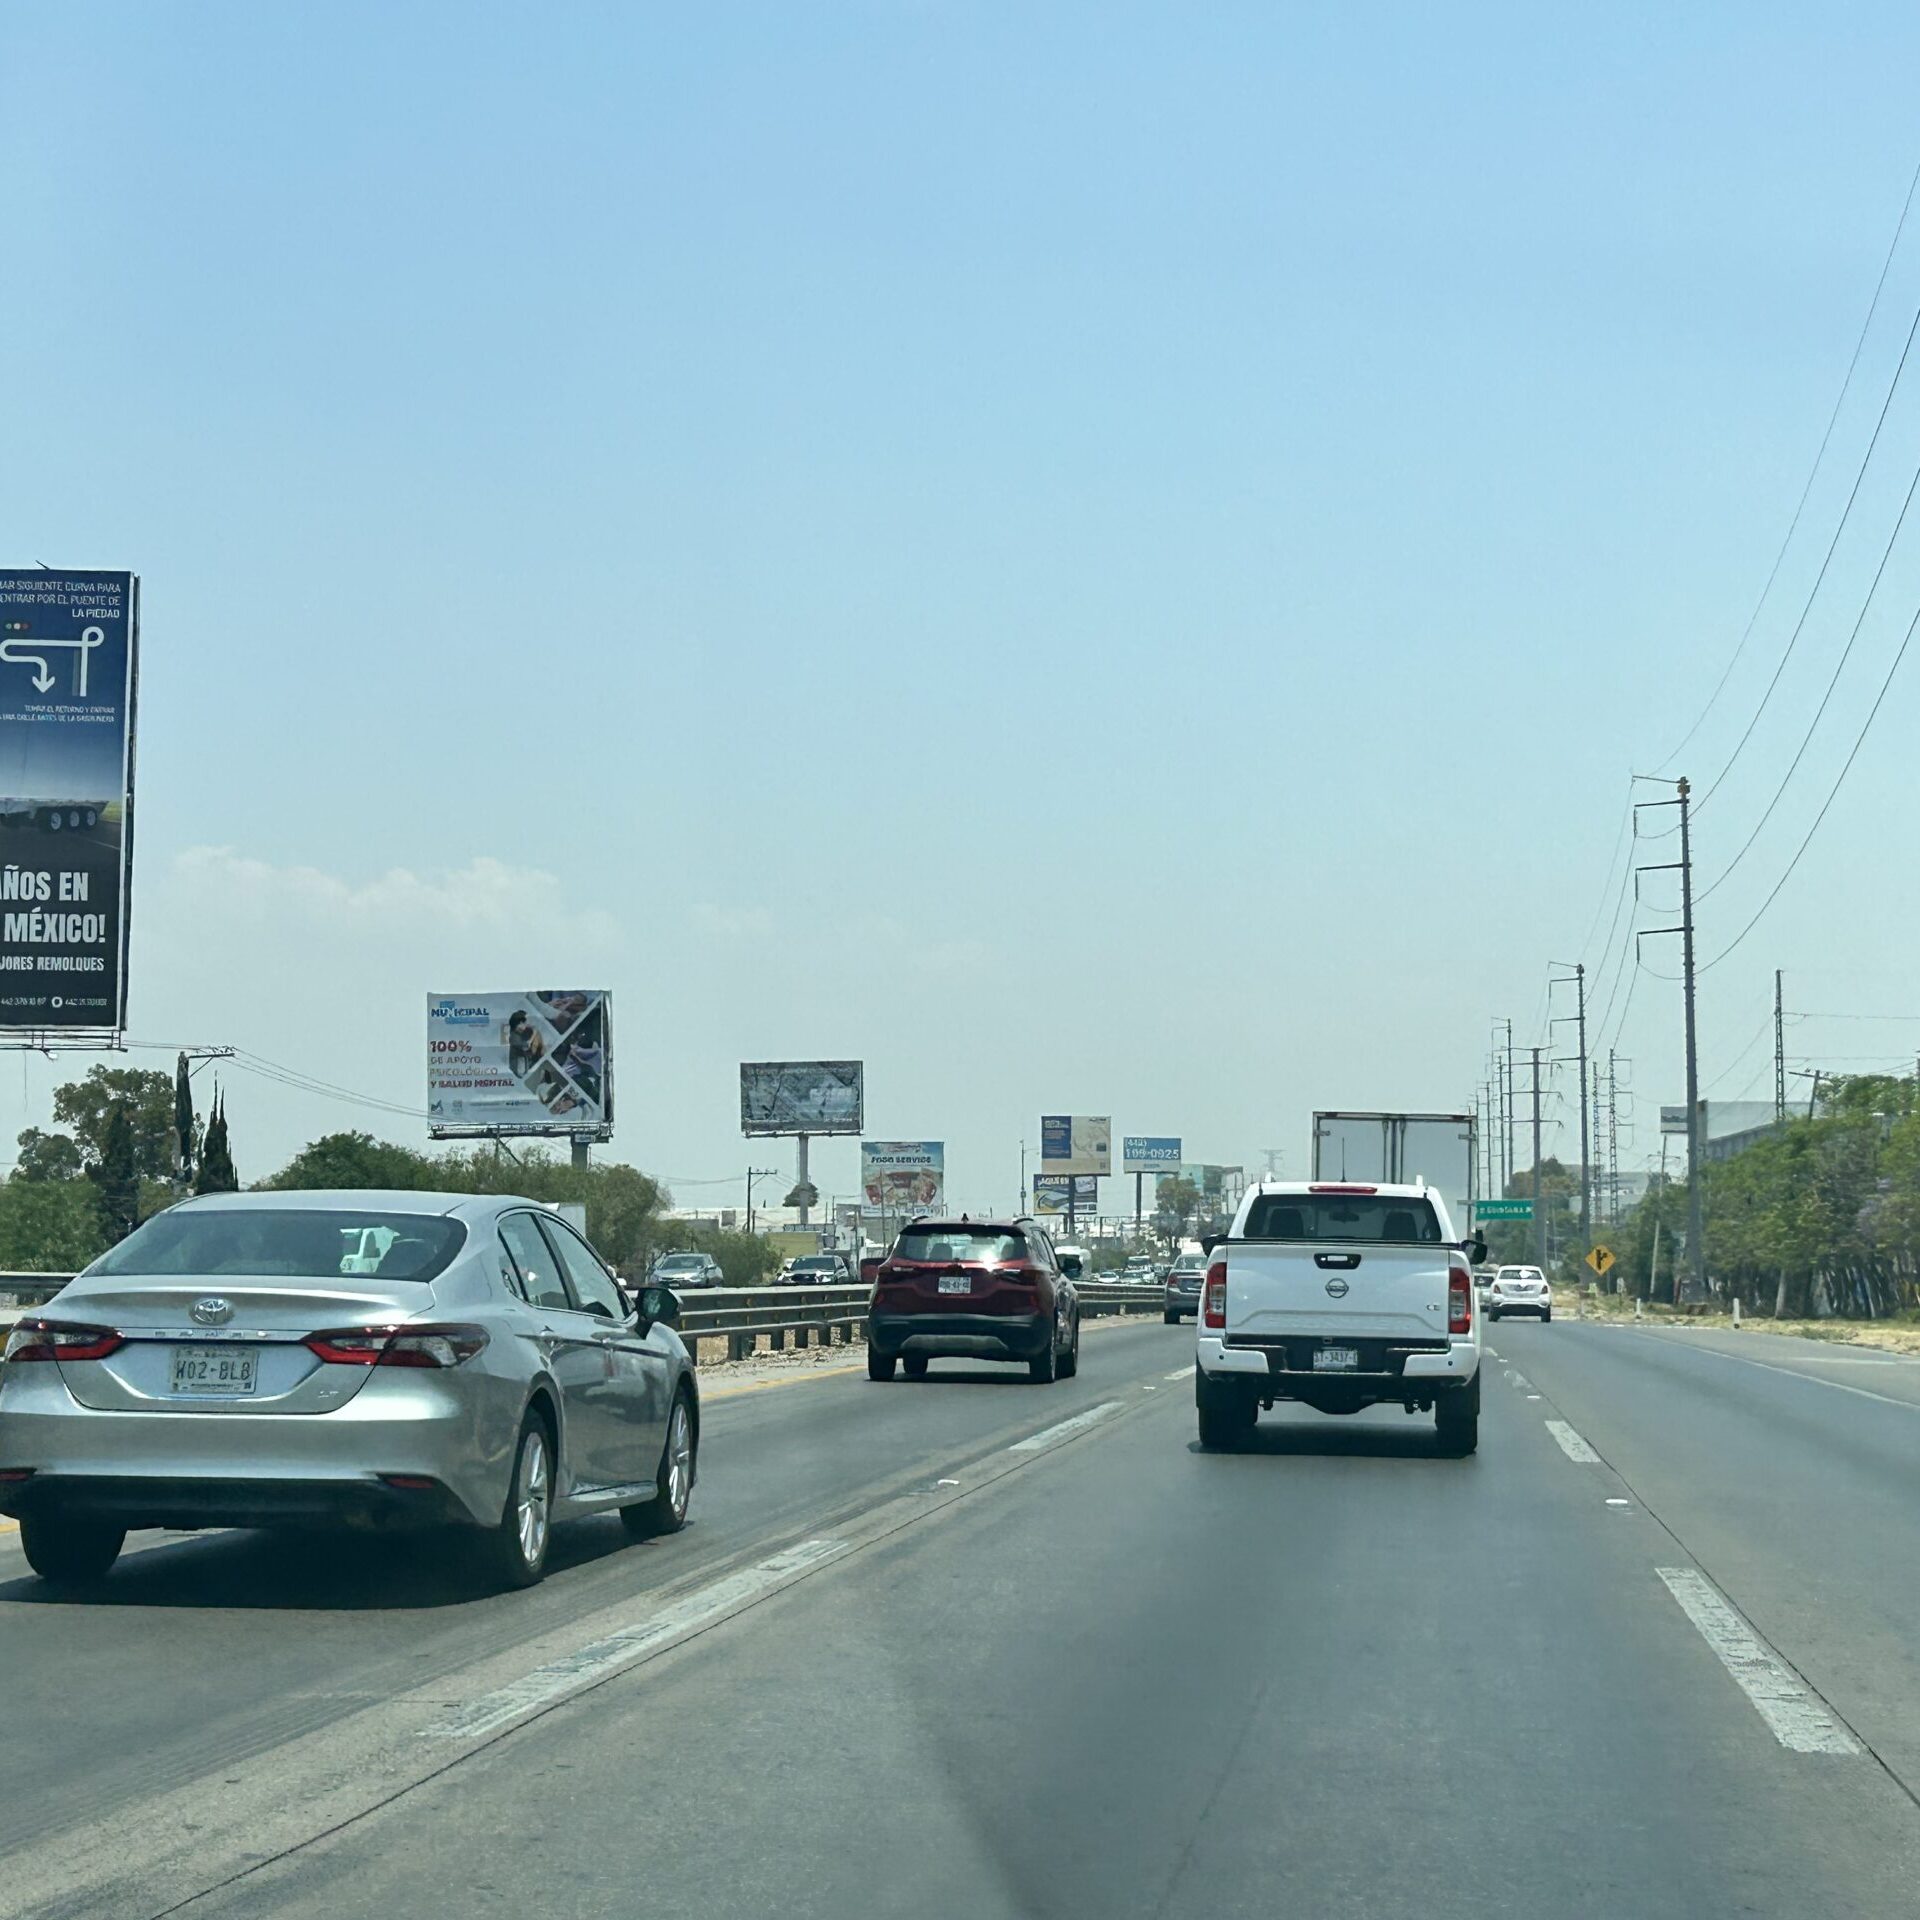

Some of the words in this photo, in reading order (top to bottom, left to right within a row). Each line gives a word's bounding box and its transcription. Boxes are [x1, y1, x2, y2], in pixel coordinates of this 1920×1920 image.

[17, 581, 62, 591] SIGUIENTE
[65, 582, 95, 592] CURVA
[97, 583, 121, 593] PARA
[37, 594, 55, 604] POR
[57, 594, 68, 605] EL
[70, 595, 105, 606] PUENTE
[108, 596, 121, 606] DE
[72, 608, 84, 618] LA
[86, 609, 120, 618] PIEDAD
[59, 872, 89, 901] EN
[4, 906, 106, 943] MÉXICO!
[37, 956, 105, 971] REMOLQUES
[430, 1040, 472, 1053] 100%
[446, 1056, 481, 1064] APOYO
[474, 1079, 515, 1088] MENTAL
